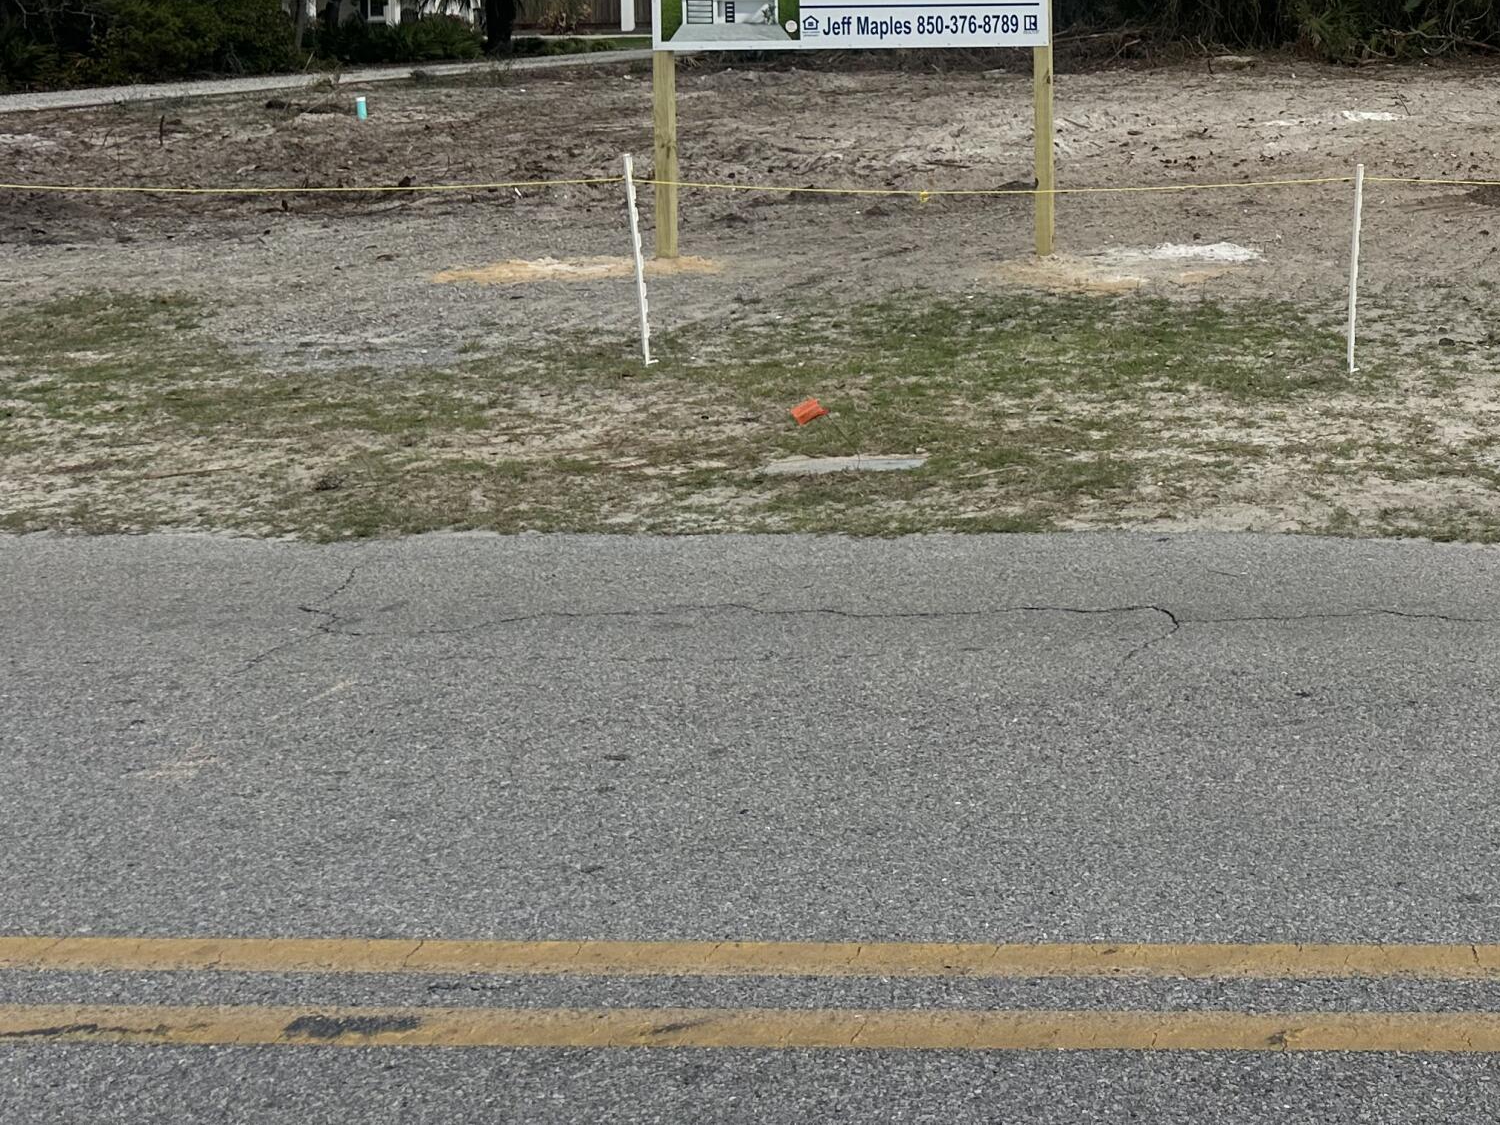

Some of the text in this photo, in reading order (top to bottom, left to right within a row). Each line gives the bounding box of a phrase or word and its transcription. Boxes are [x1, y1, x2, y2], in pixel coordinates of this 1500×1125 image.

[823, 15, 1019, 40] Jeff Maples 850-376-8789
